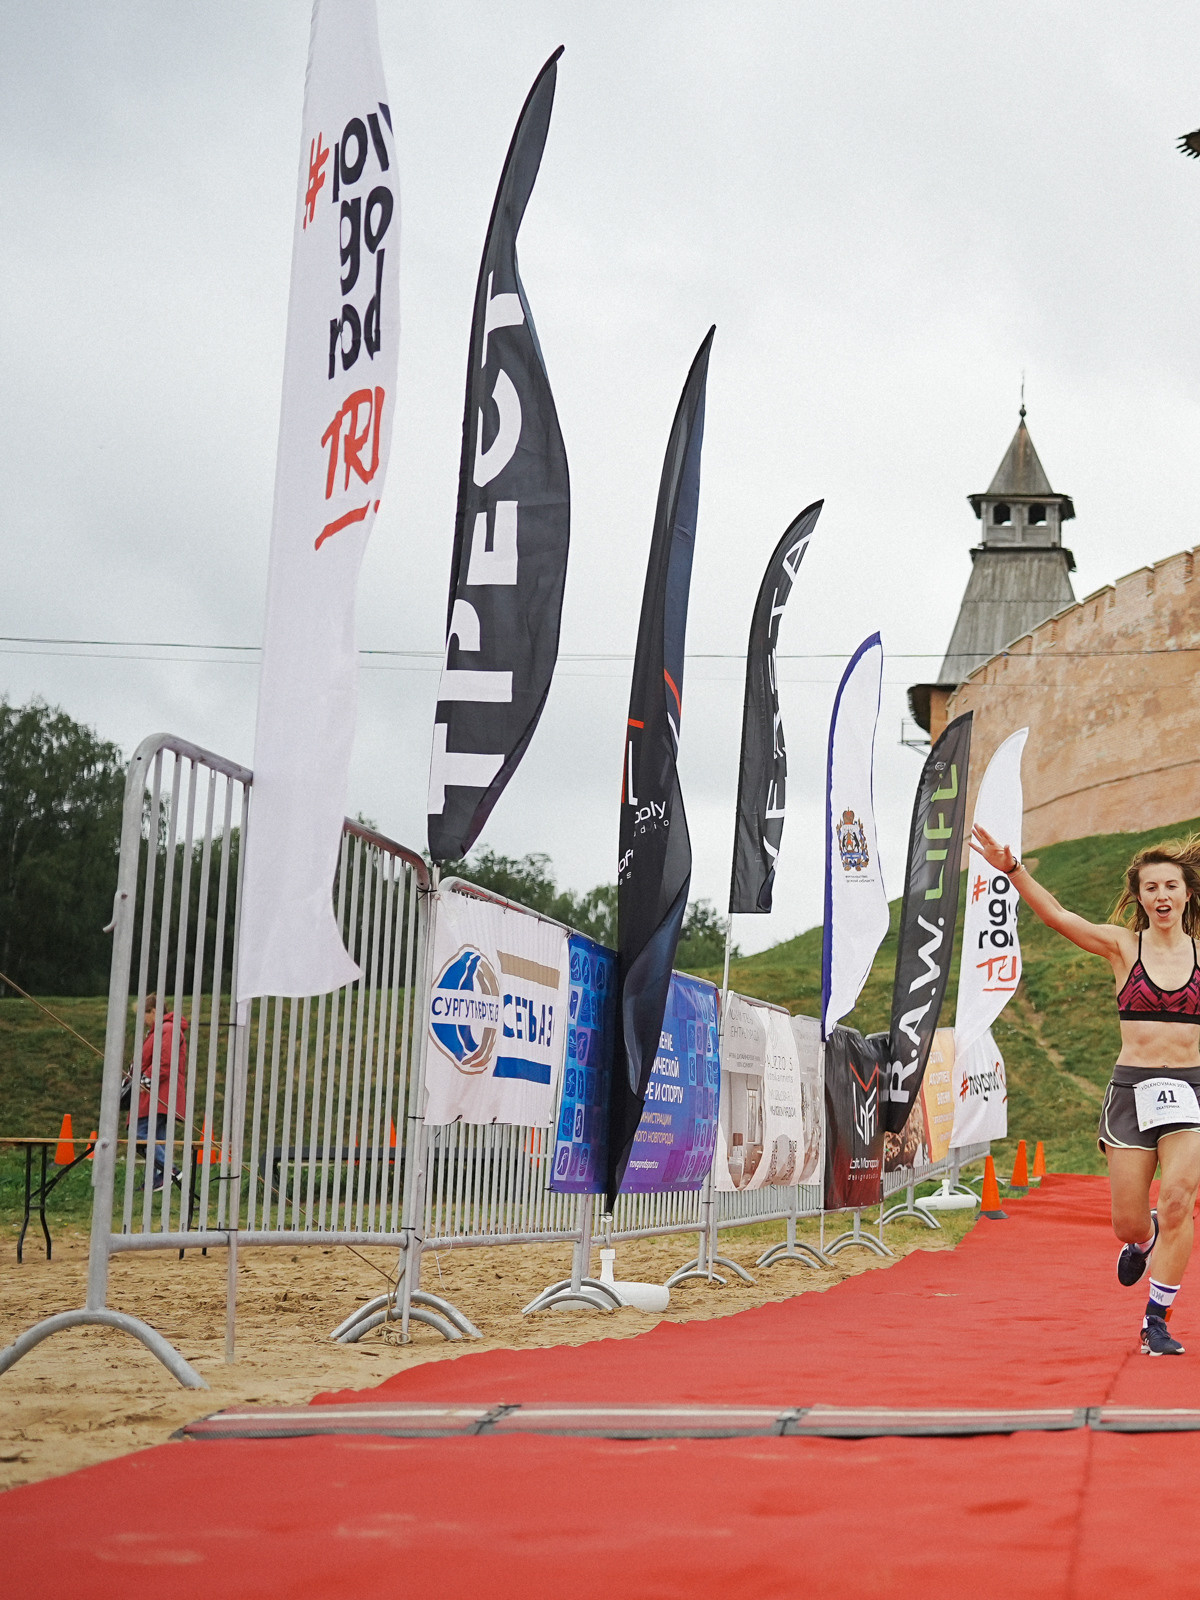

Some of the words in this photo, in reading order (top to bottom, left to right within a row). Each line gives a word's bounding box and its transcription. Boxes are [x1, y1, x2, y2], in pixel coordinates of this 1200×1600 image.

[338, 185, 394, 297] go
[327, 248, 385, 380] rod
[319, 385, 386, 500] TRI
[1156, 1089, 1177, 1104] 41
